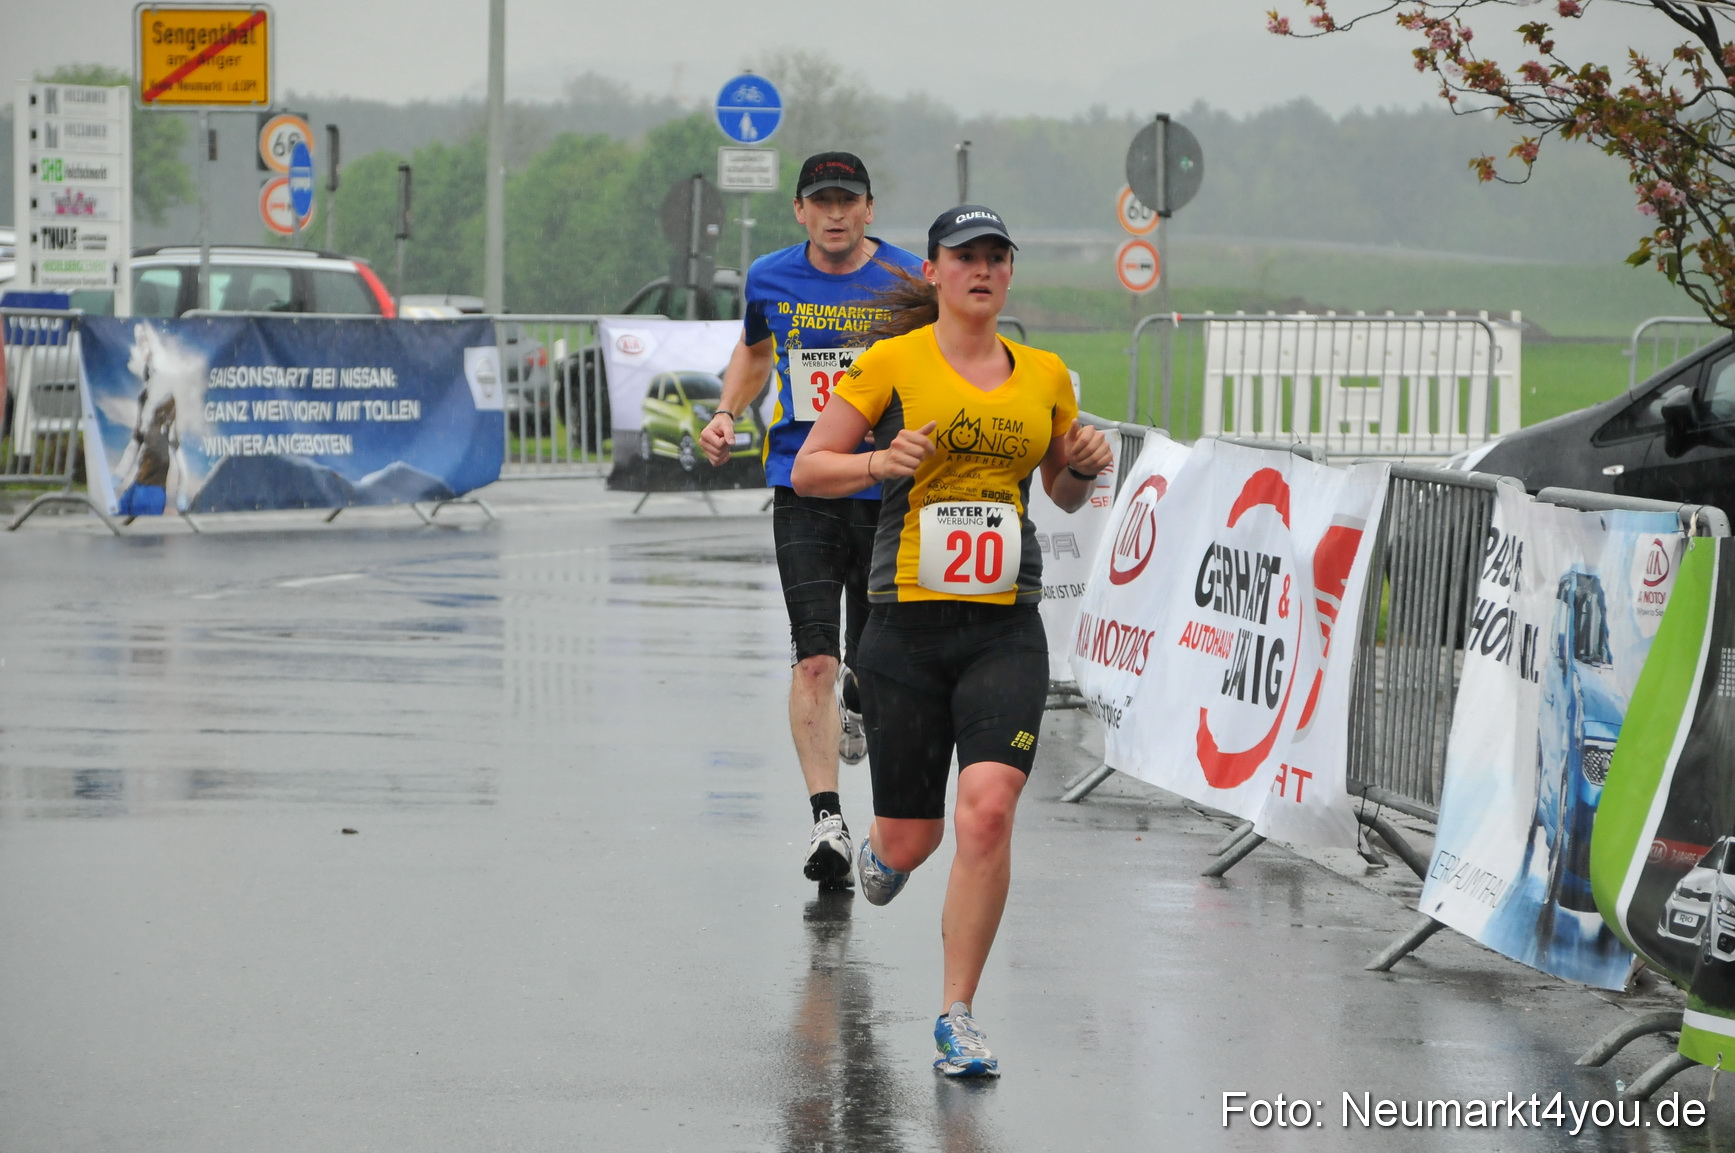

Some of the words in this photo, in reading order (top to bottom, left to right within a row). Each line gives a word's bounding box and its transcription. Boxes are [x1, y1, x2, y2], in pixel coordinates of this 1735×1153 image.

[152, 21, 256, 50] Sengenthal
[166, 54, 189, 66] am
[955, 211, 1001, 228] QUELLE
[777, 302, 793, 315] 10.
[796, 302, 892, 322] NEUMARKTER
[792, 315, 872, 333] STADTLAUF
[801, 352, 836, 362] MEYER
[801, 361, 838, 369] WERBUNG
[208, 366, 308, 389] SAISONSTART
[311, 367, 336, 390] BEI
[205, 400, 249, 423] GANZ
[252, 400, 289, 422] WEIT
[336, 400, 361, 422] MIT
[362, 399, 420, 421] TOLLEN
[992, 417, 1023, 434] TEAM
[947, 454, 1013, 469] APOTHEKE
[937, 506, 983, 518] MEYER
[937, 517, 984, 527] WERBUNG
[943, 529, 1004, 584] 20
[1057, 585, 1069, 599] IST
[1278, 573, 1291, 620] &
[1091, 617, 1156, 677] MOTORS
[1178, 620, 1234, 660] AUTOHAUS
[1679, 913, 1693, 924] RIO
